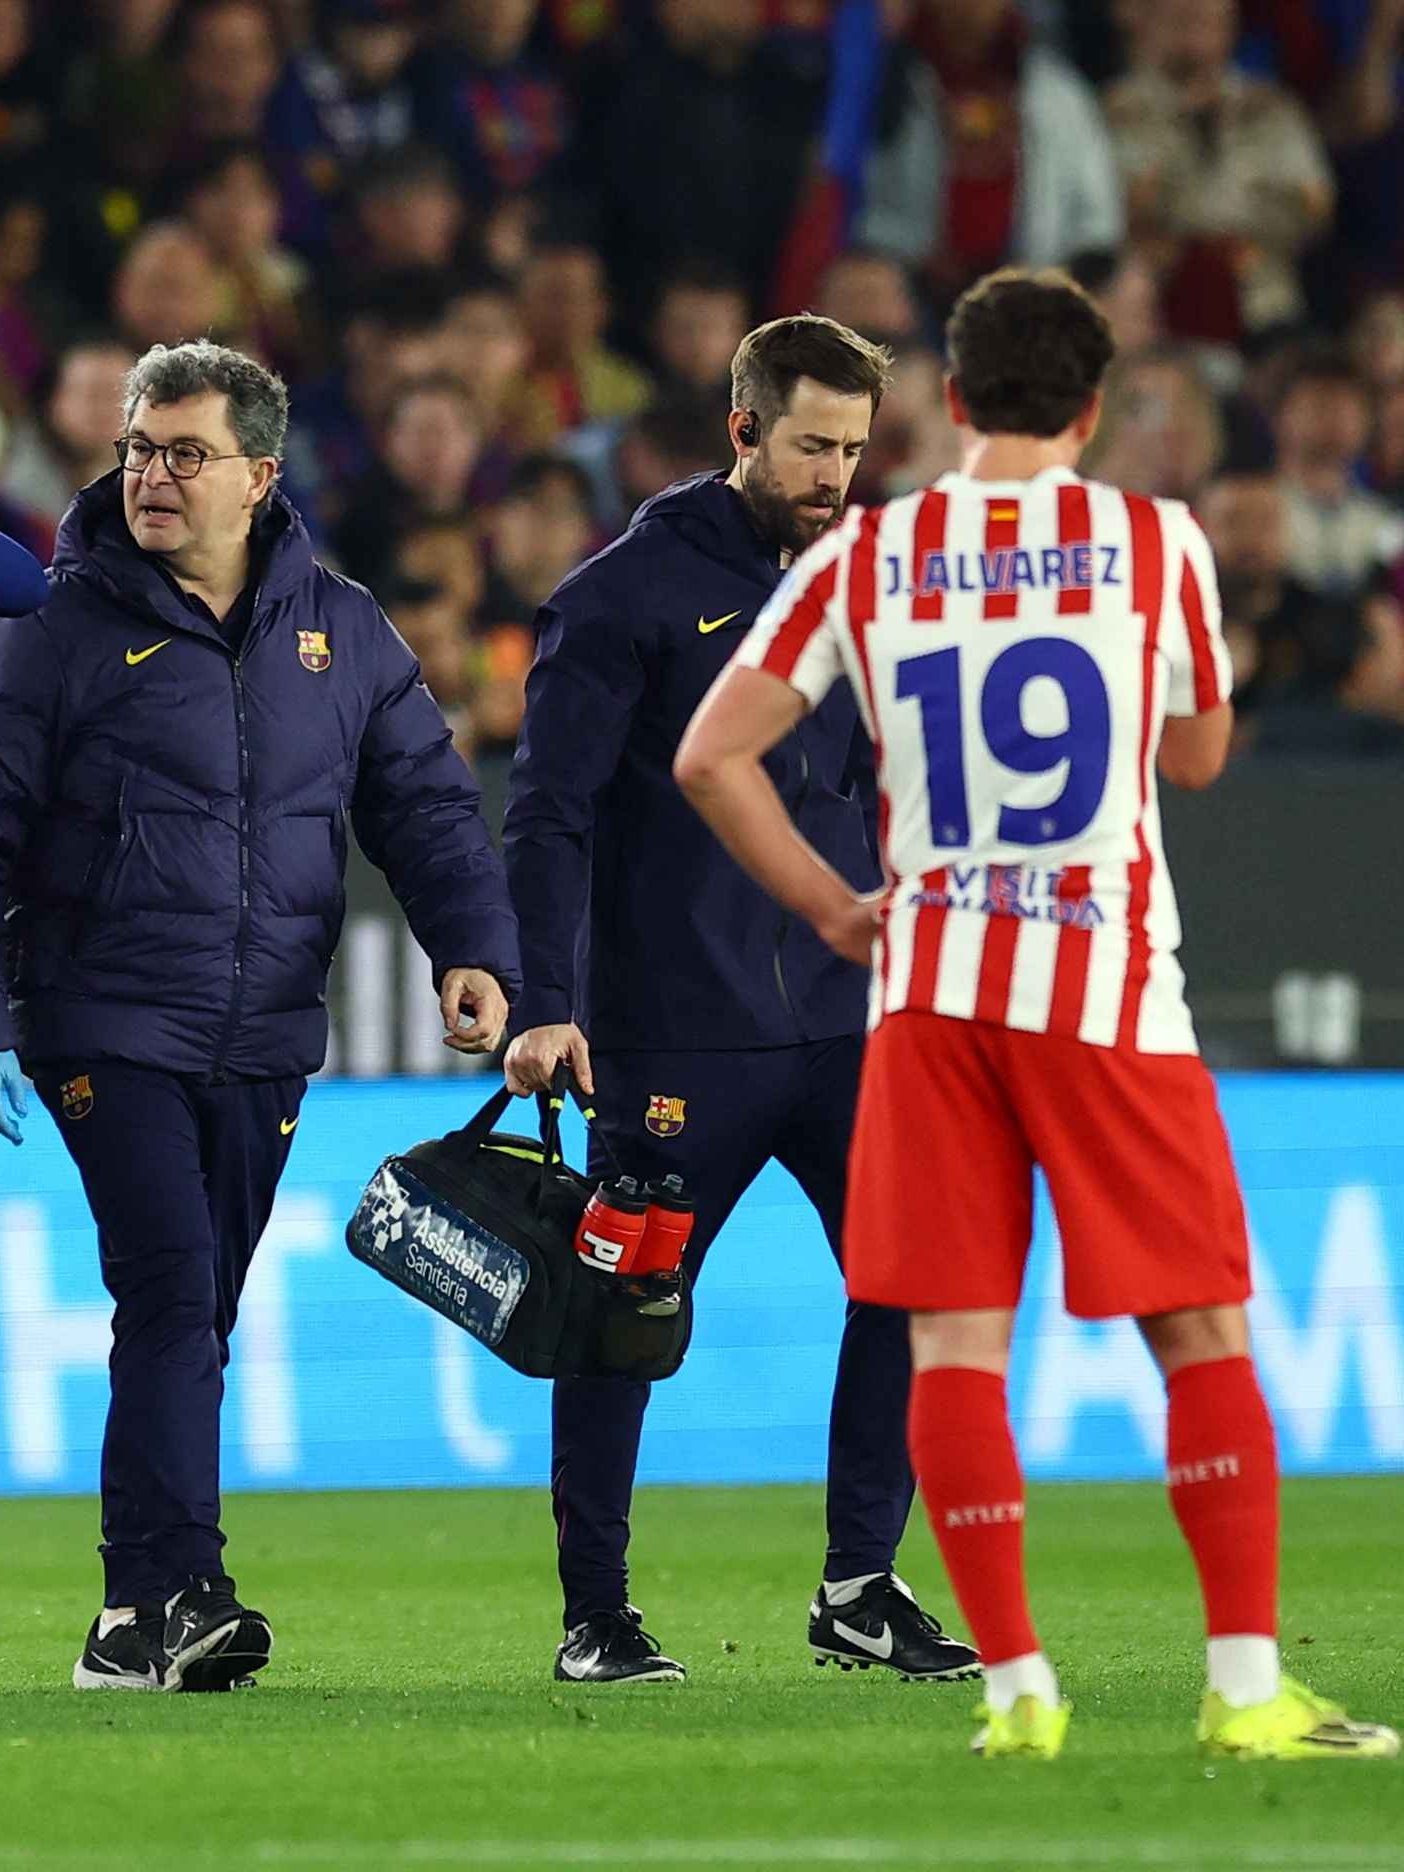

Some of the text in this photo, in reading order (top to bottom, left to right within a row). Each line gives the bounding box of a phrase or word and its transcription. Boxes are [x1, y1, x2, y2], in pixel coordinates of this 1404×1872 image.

[895, 637, 1111, 849] 19
[951, 863, 1067, 898] VISIT
[405, 1243, 468, 1306] Sanitària
[413, 1216, 507, 1300] Assistència
[1167, 1455, 1239, 1488] TLETI
